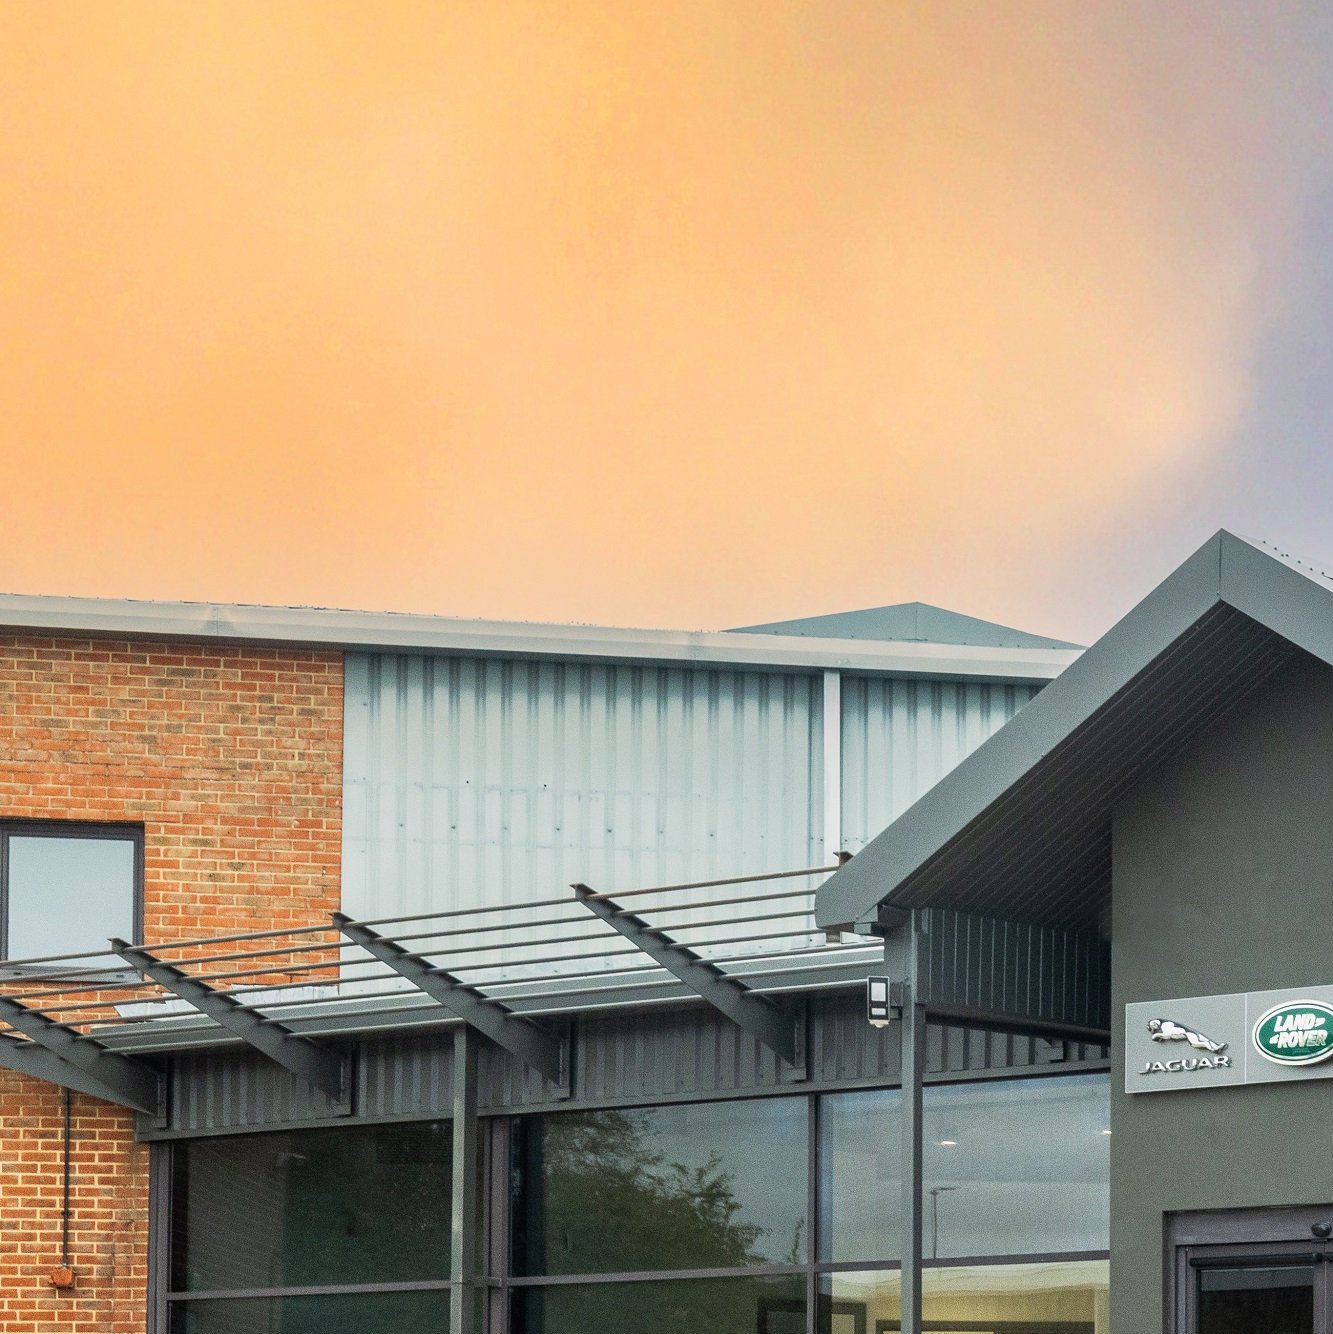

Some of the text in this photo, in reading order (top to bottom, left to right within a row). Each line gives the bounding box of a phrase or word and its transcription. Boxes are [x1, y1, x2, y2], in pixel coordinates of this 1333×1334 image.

[1273, 1013, 1317, 1032] LAND
[1277, 1029, 1328, 1048] ROVER
[1138, 1055, 1231, 1074] JAGUAR
